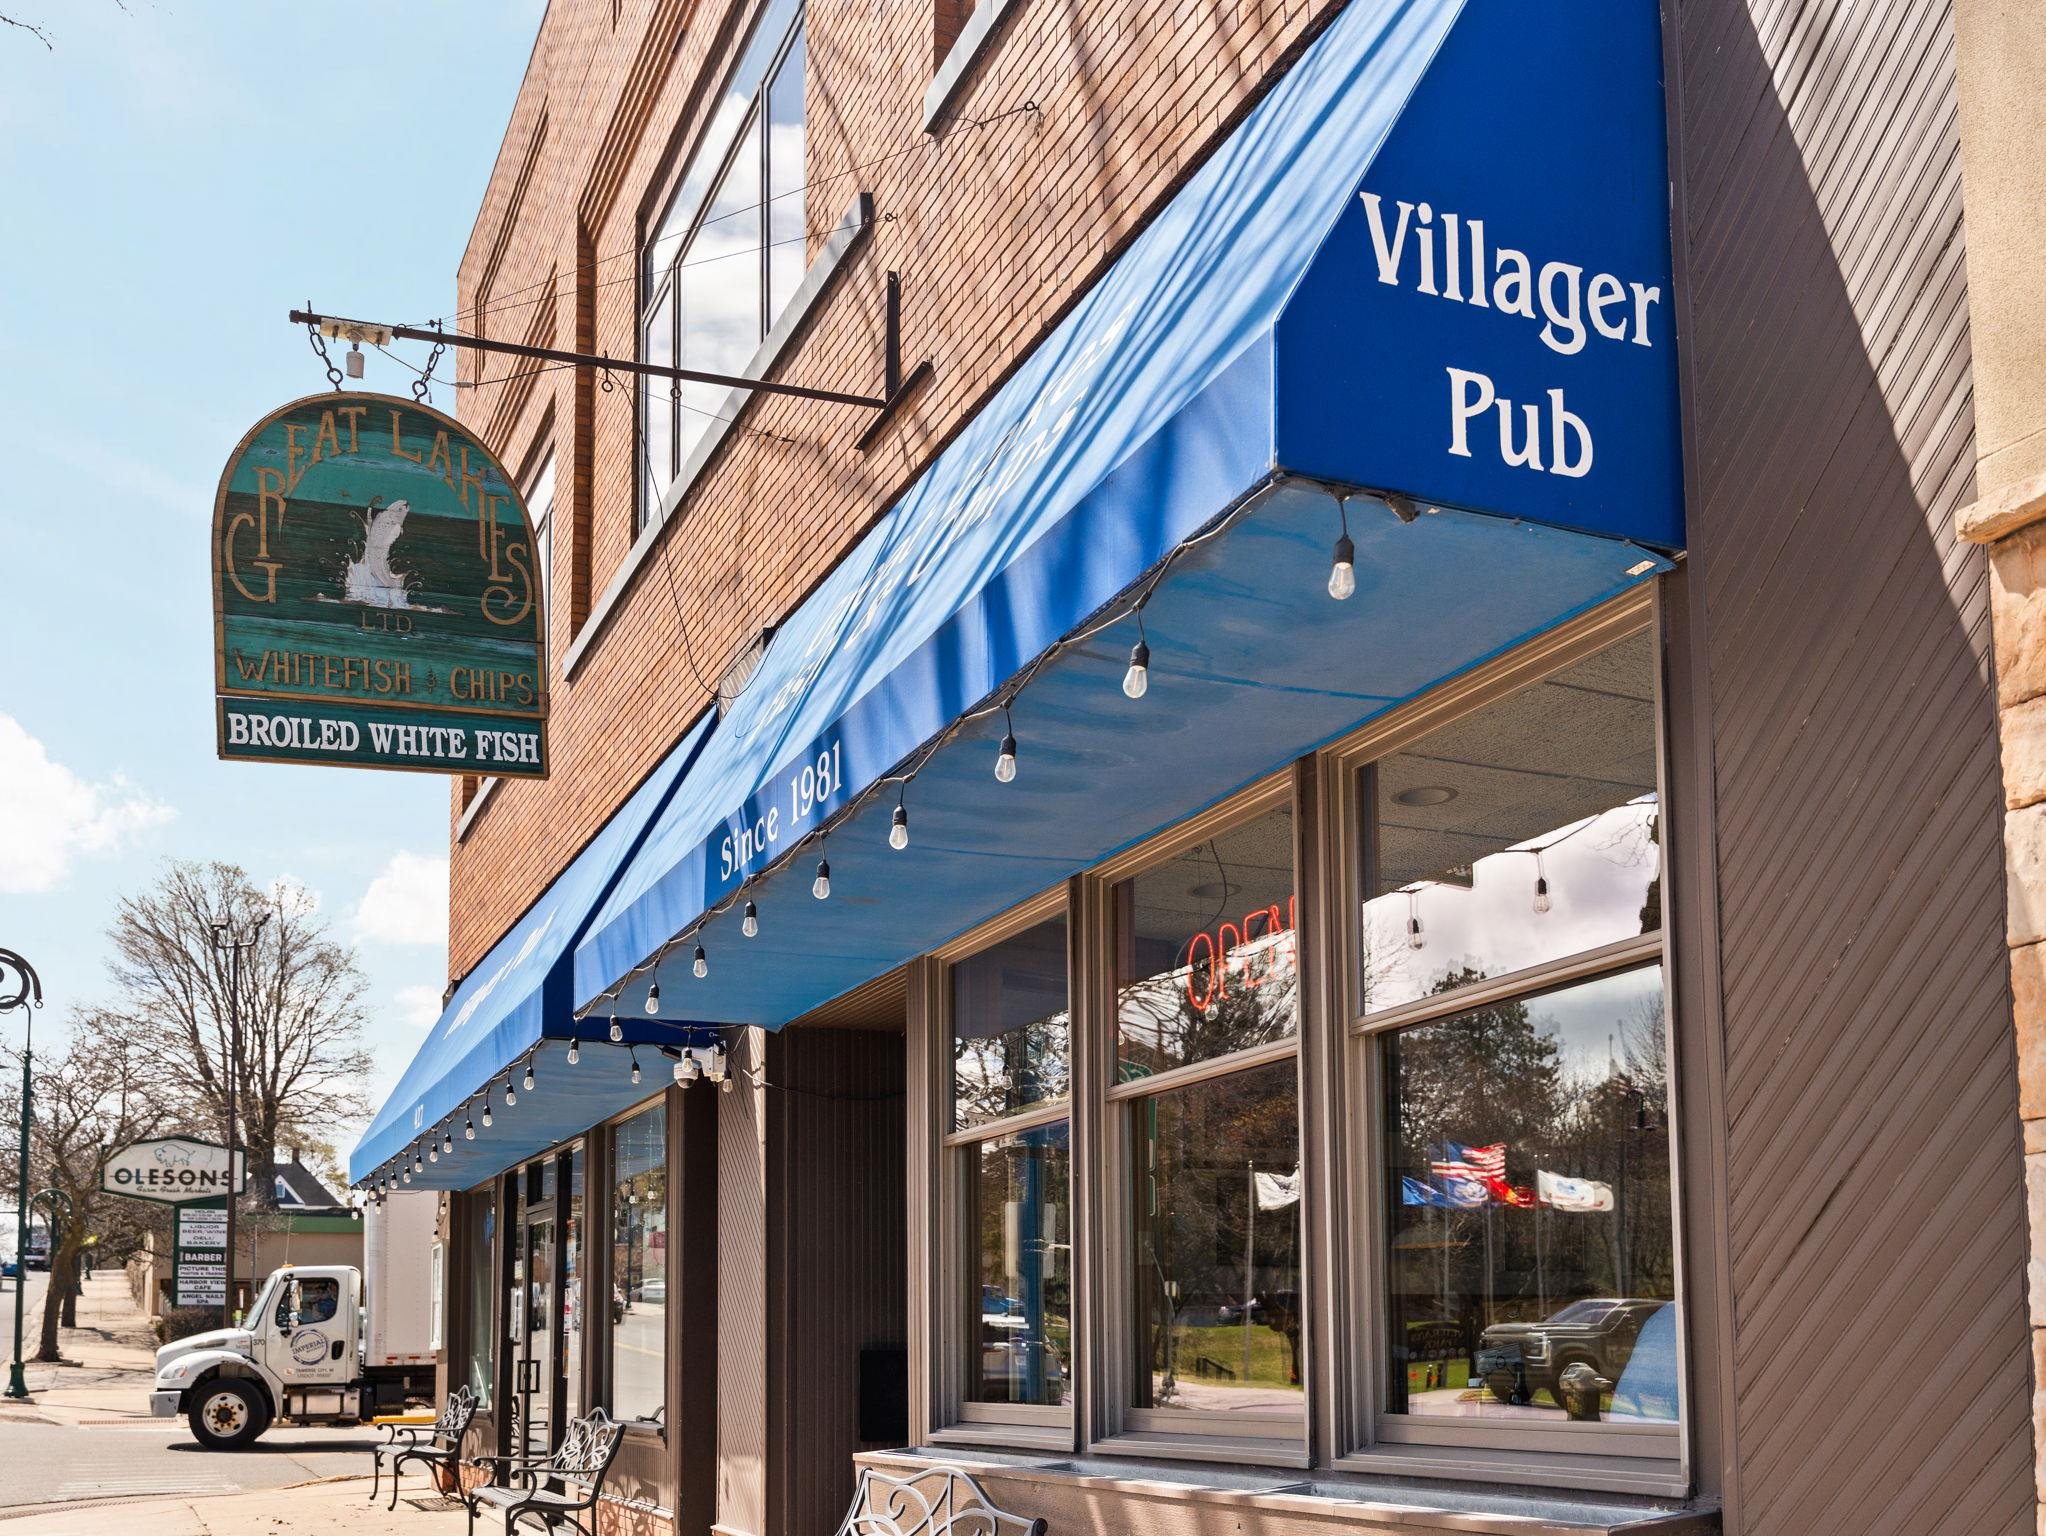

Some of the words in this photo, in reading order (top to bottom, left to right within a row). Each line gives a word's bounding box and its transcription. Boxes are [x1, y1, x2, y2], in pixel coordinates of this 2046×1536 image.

[1359, 190, 1661, 355] Villager
[1446, 366, 1594, 478] Pub
[224, 406, 367, 604] GREAT
[388, 409, 533, 625] LAKES
[803, 497, 942, 658] Great
[937, 297, 1137, 524] Lakes
[748, 624, 846, 741] Fish
[843, 573, 902, 650] &
[906, 382, 1092, 588] Chips
[360, 611, 412, 633] LTD
[232, 648, 412, 694] WHITEFISH
[450, 666, 534, 705] CHIPS
[227, 712, 360, 752] BROILED
[368, 721, 467, 759] WHITE
[475, 729, 540, 763] FISH
[720, 805, 779, 882] Since
[790, 739, 842, 826] 1981
[1188, 895, 1295, 1011] OPEN
[114, 1168, 229, 1186] OLESONS
[184, 1253, 222, 1261] BARBER
[253, 1338, 265, 1346] 370
[292, 1340, 326, 1355] IMPERIAL
